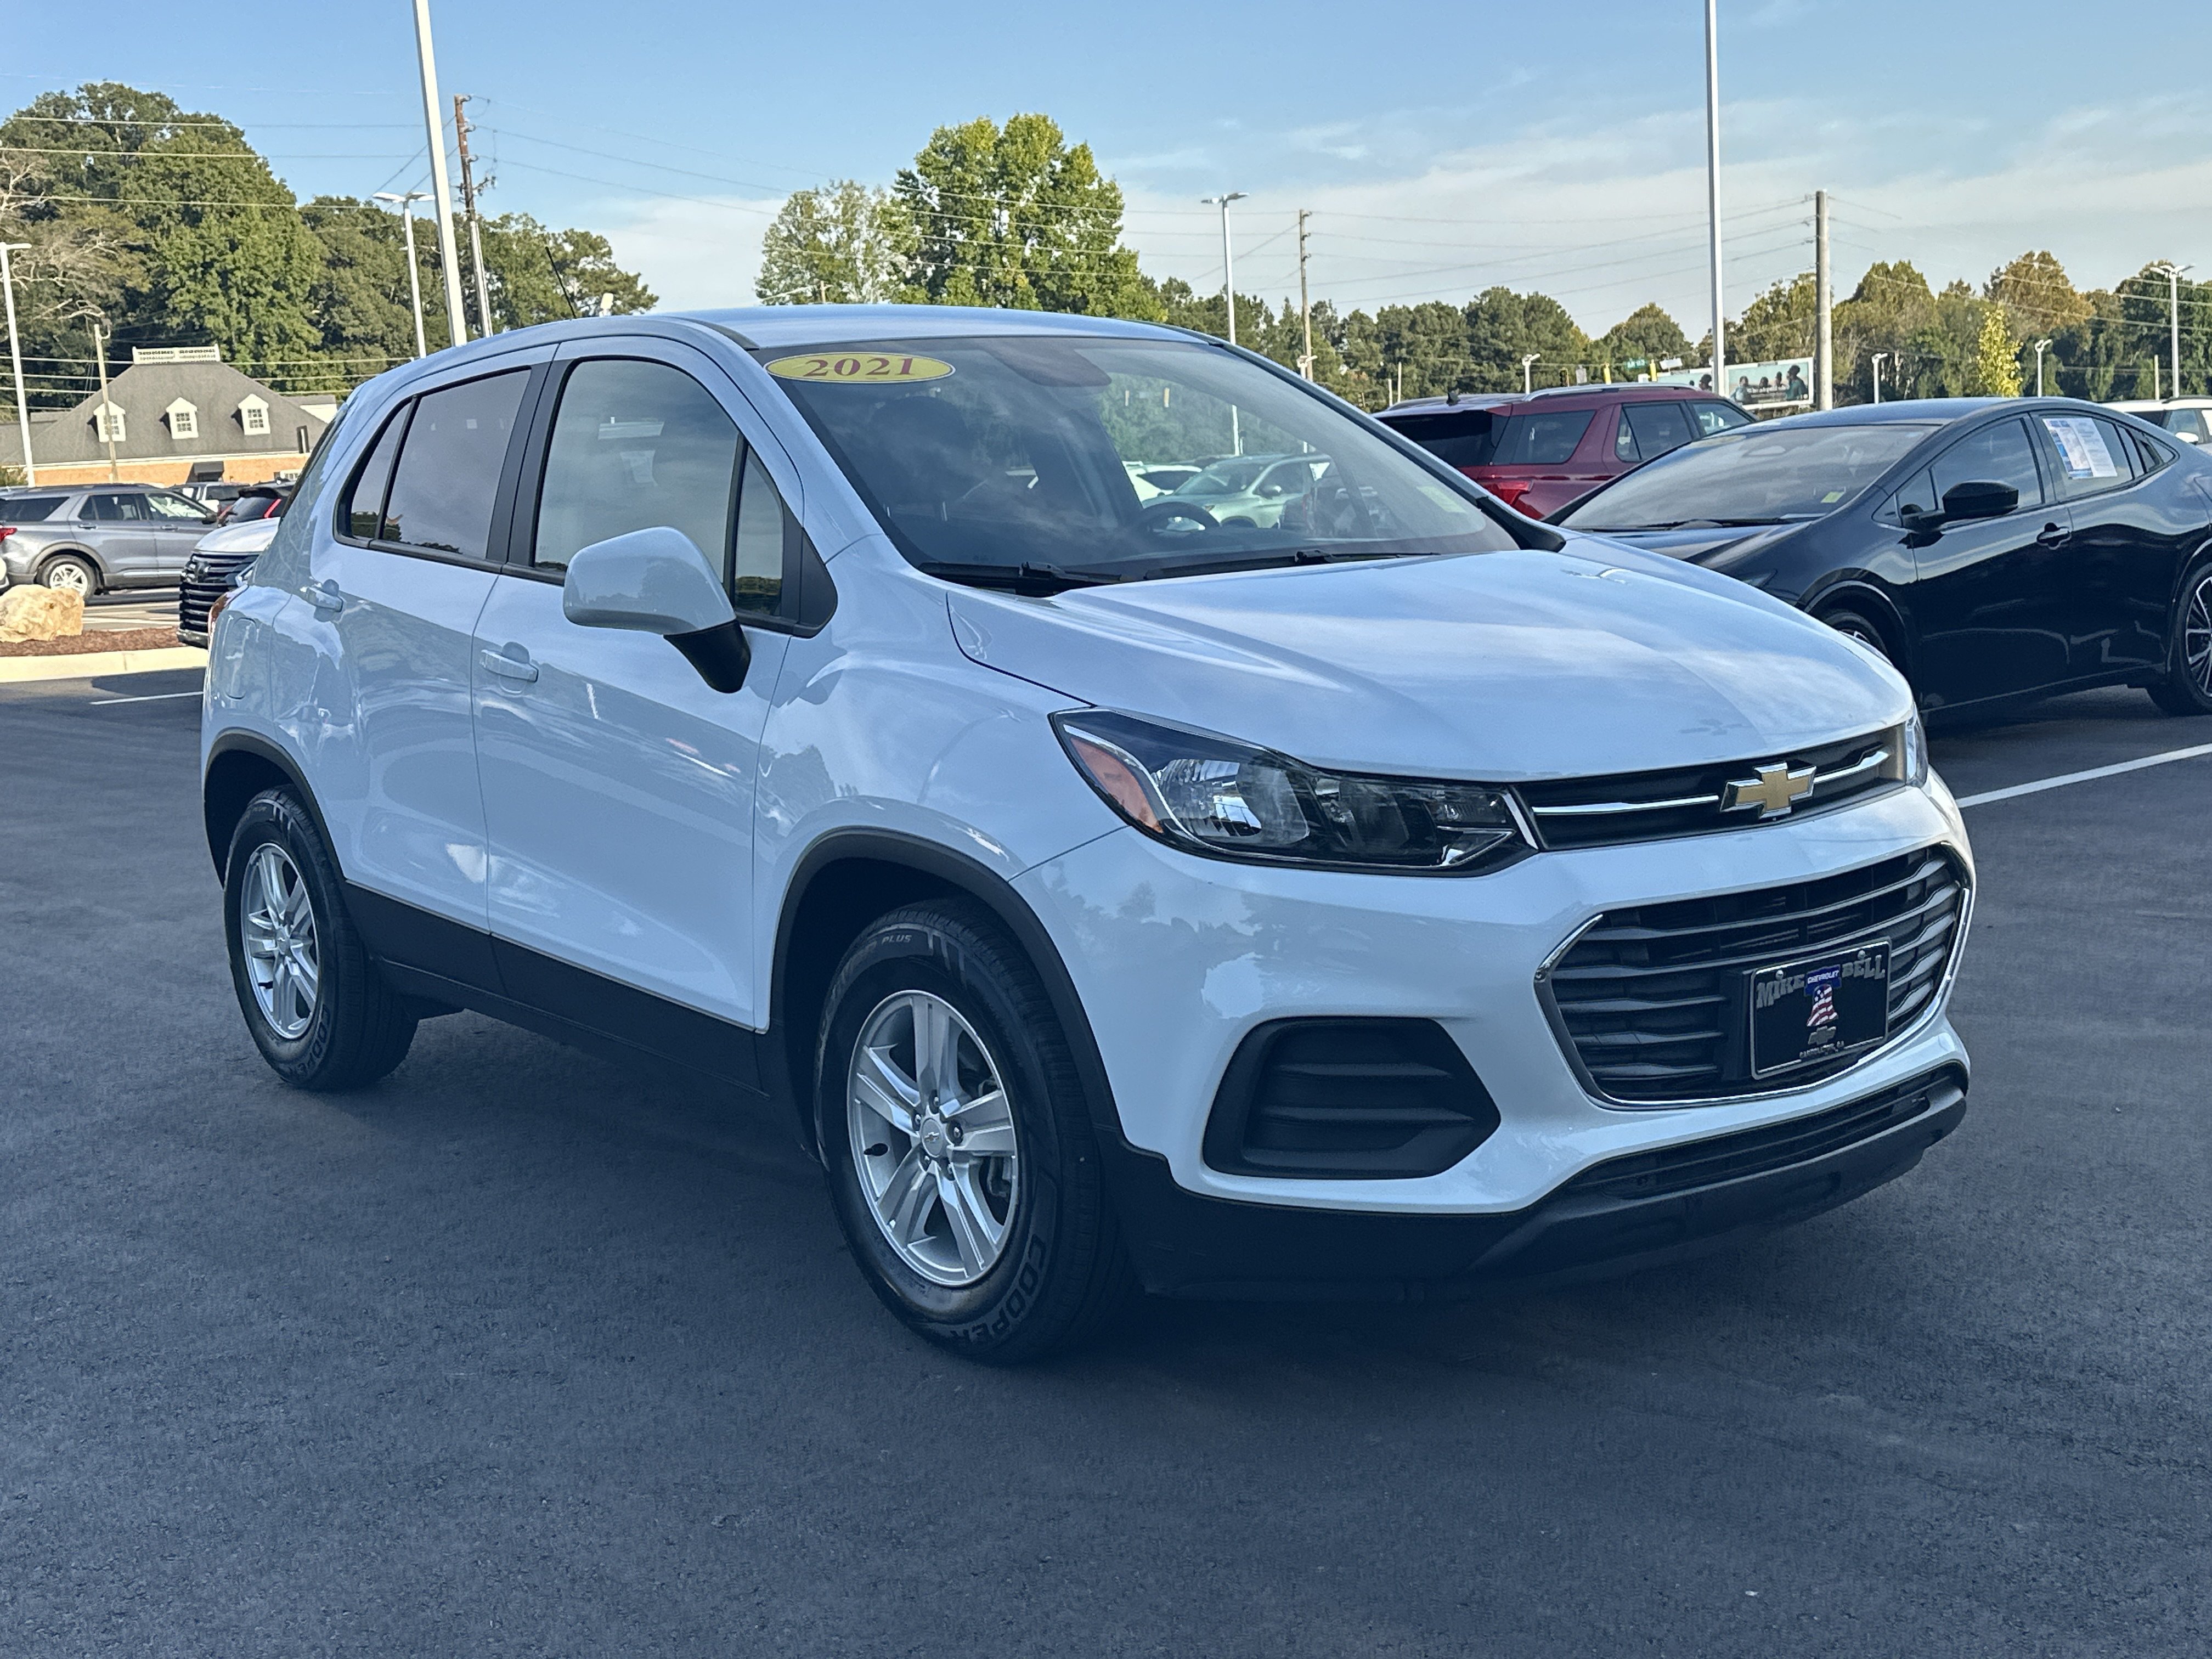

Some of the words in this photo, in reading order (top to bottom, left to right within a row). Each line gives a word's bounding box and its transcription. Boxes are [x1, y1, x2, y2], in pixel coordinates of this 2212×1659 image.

[803, 358, 913, 377] 2021
[882, 934, 912, 944] PLUS
[1757, 974, 1805, 1009] MIKE
[1842, 955, 1886, 980] BELL
